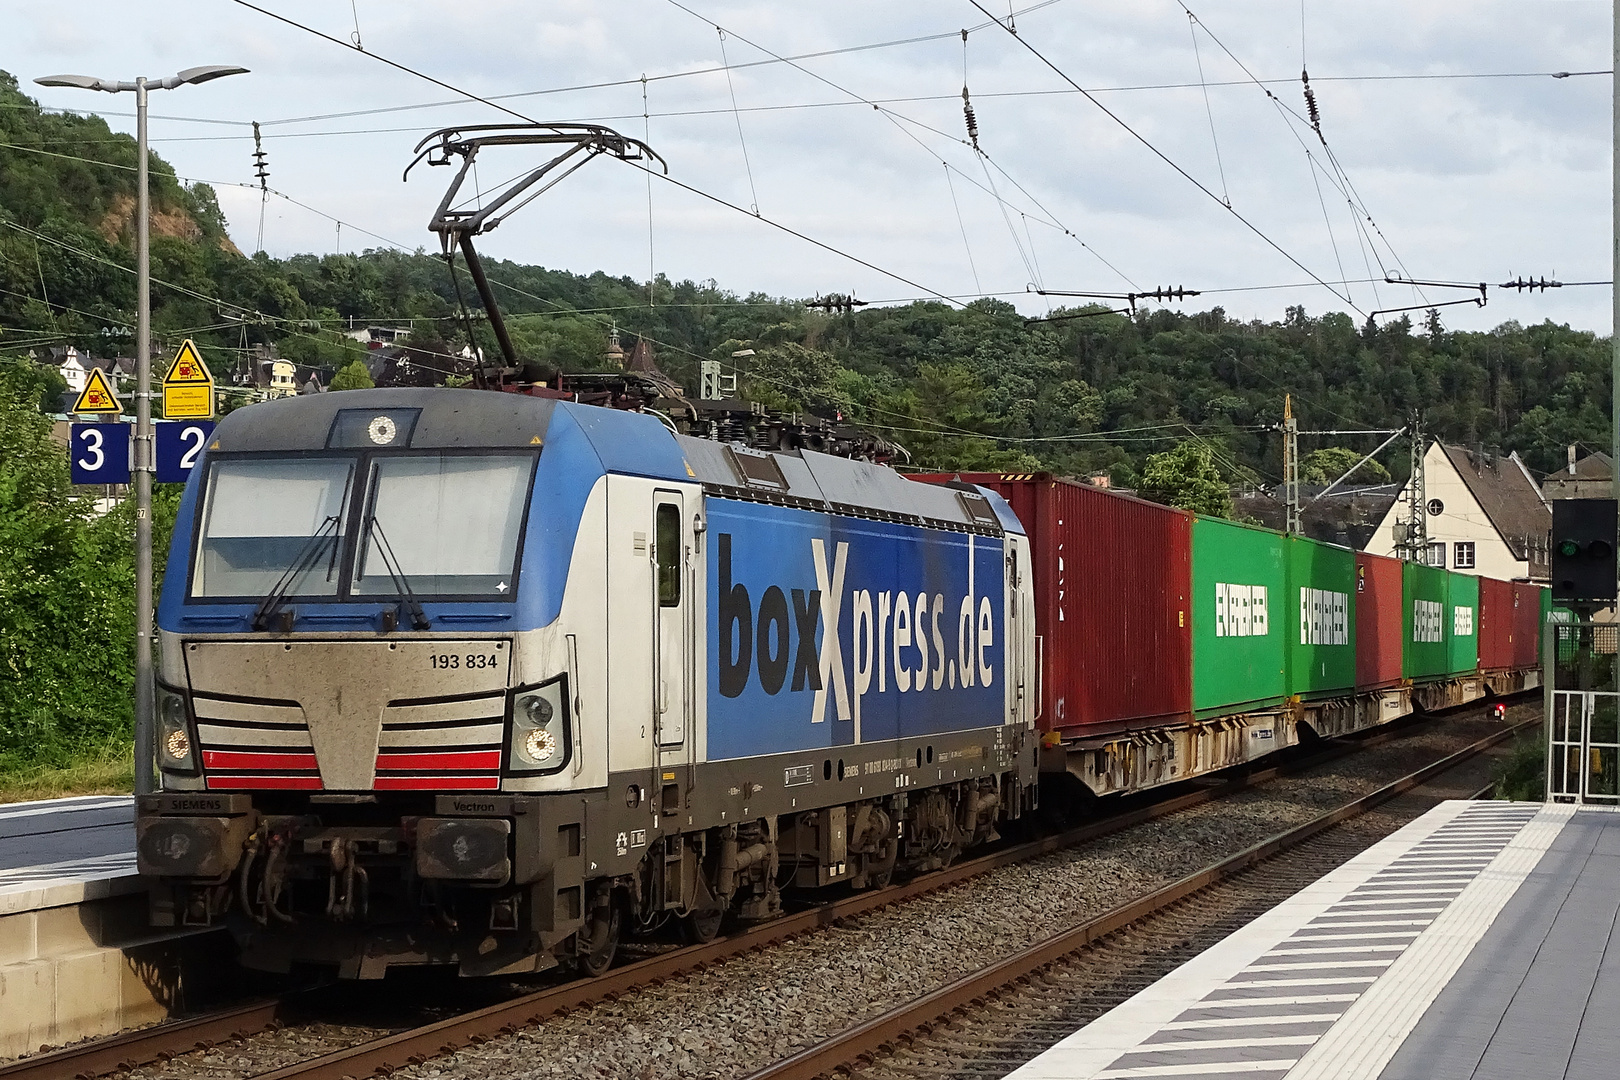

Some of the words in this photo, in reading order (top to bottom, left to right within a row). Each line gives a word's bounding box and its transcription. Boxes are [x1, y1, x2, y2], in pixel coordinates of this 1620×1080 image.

[78, 428, 105, 471] 3
[179, 426, 205, 469] 2
[717, 533, 993, 745] boxXpress.de
[430, 654, 460, 670] 193
[466, 653, 498, 669] 834
[640, 725, 645, 738] 2
[171, 798, 221, 812] SIEMENS
[453, 800, 495, 812] Vectron
